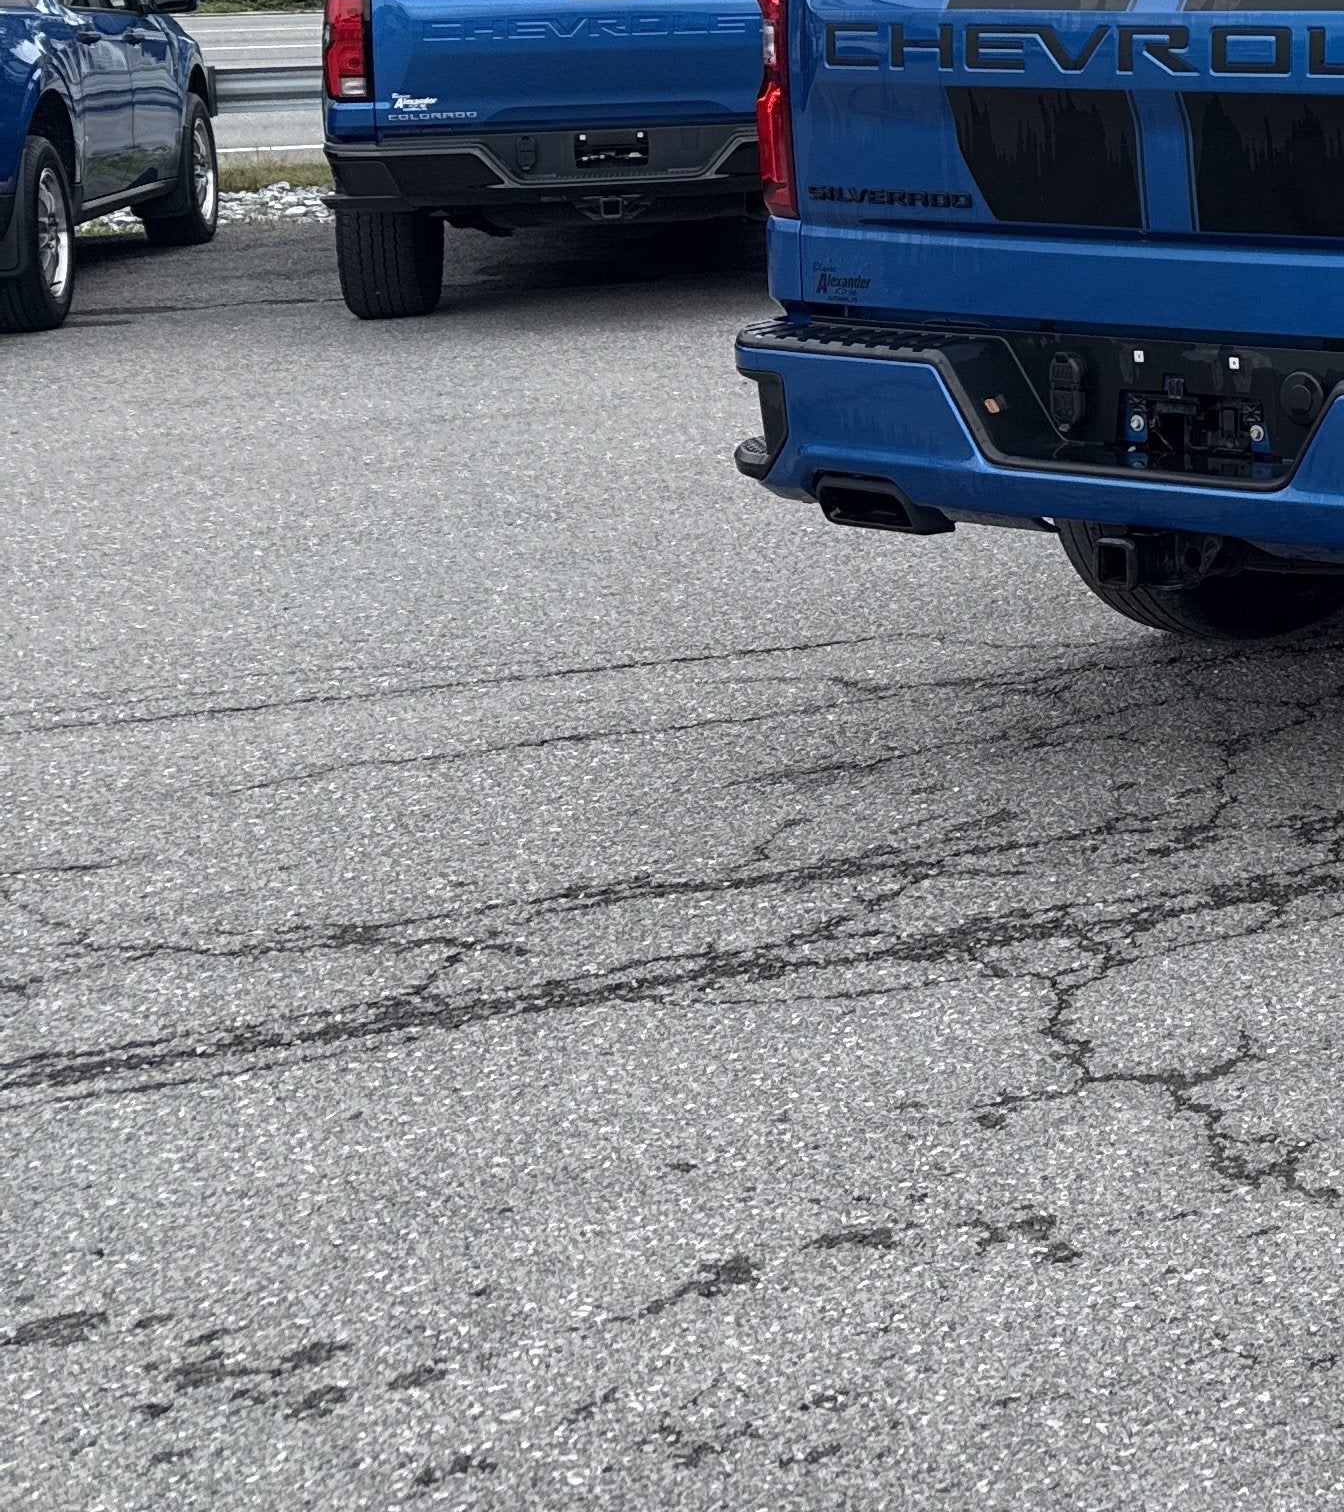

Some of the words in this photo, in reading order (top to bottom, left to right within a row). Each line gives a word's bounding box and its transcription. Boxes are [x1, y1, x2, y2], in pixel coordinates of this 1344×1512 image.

[387, 111, 478, 121] COLORADO
[807, 184, 973, 209] SILVERADO
[815, 272, 872, 294] Alexander
